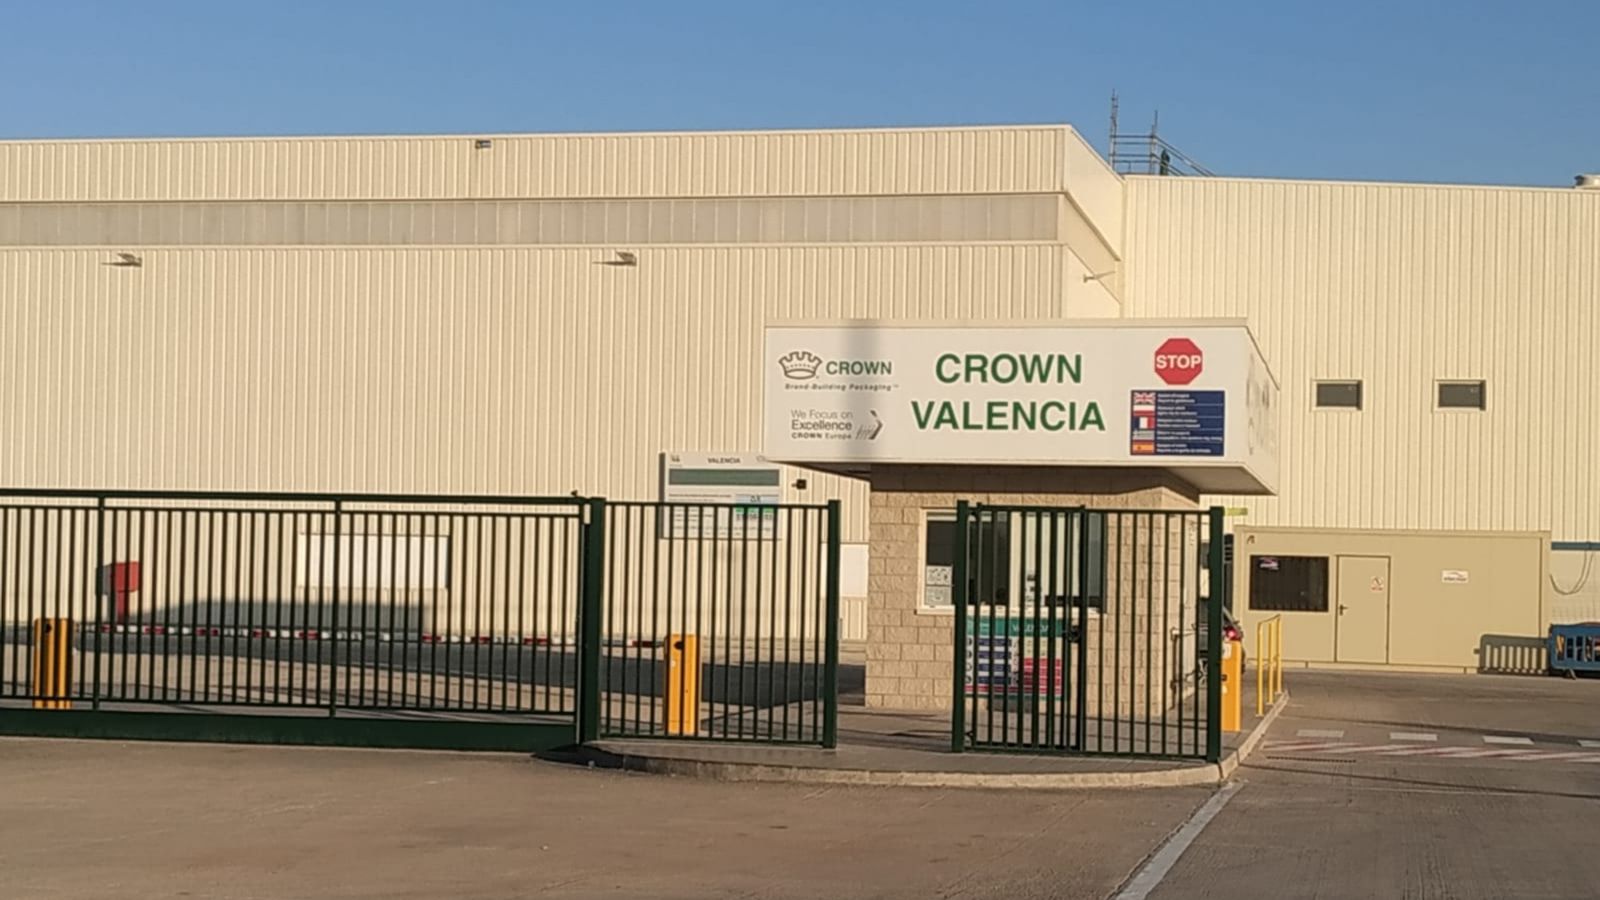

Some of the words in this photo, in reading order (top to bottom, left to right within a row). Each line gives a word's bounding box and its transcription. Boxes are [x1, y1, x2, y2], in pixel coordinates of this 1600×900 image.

[826, 361, 892, 375] CROWN
[935, 354, 1082, 383] CROWN
[1156, 354, 1201, 369] STOP
[791, 409, 807, 419] We
[809, 409, 838, 419] Focus
[840, 411, 853, 419] on
[911, 400, 1106, 431] VALENCIA
[791, 419, 852, 430] Excellence
